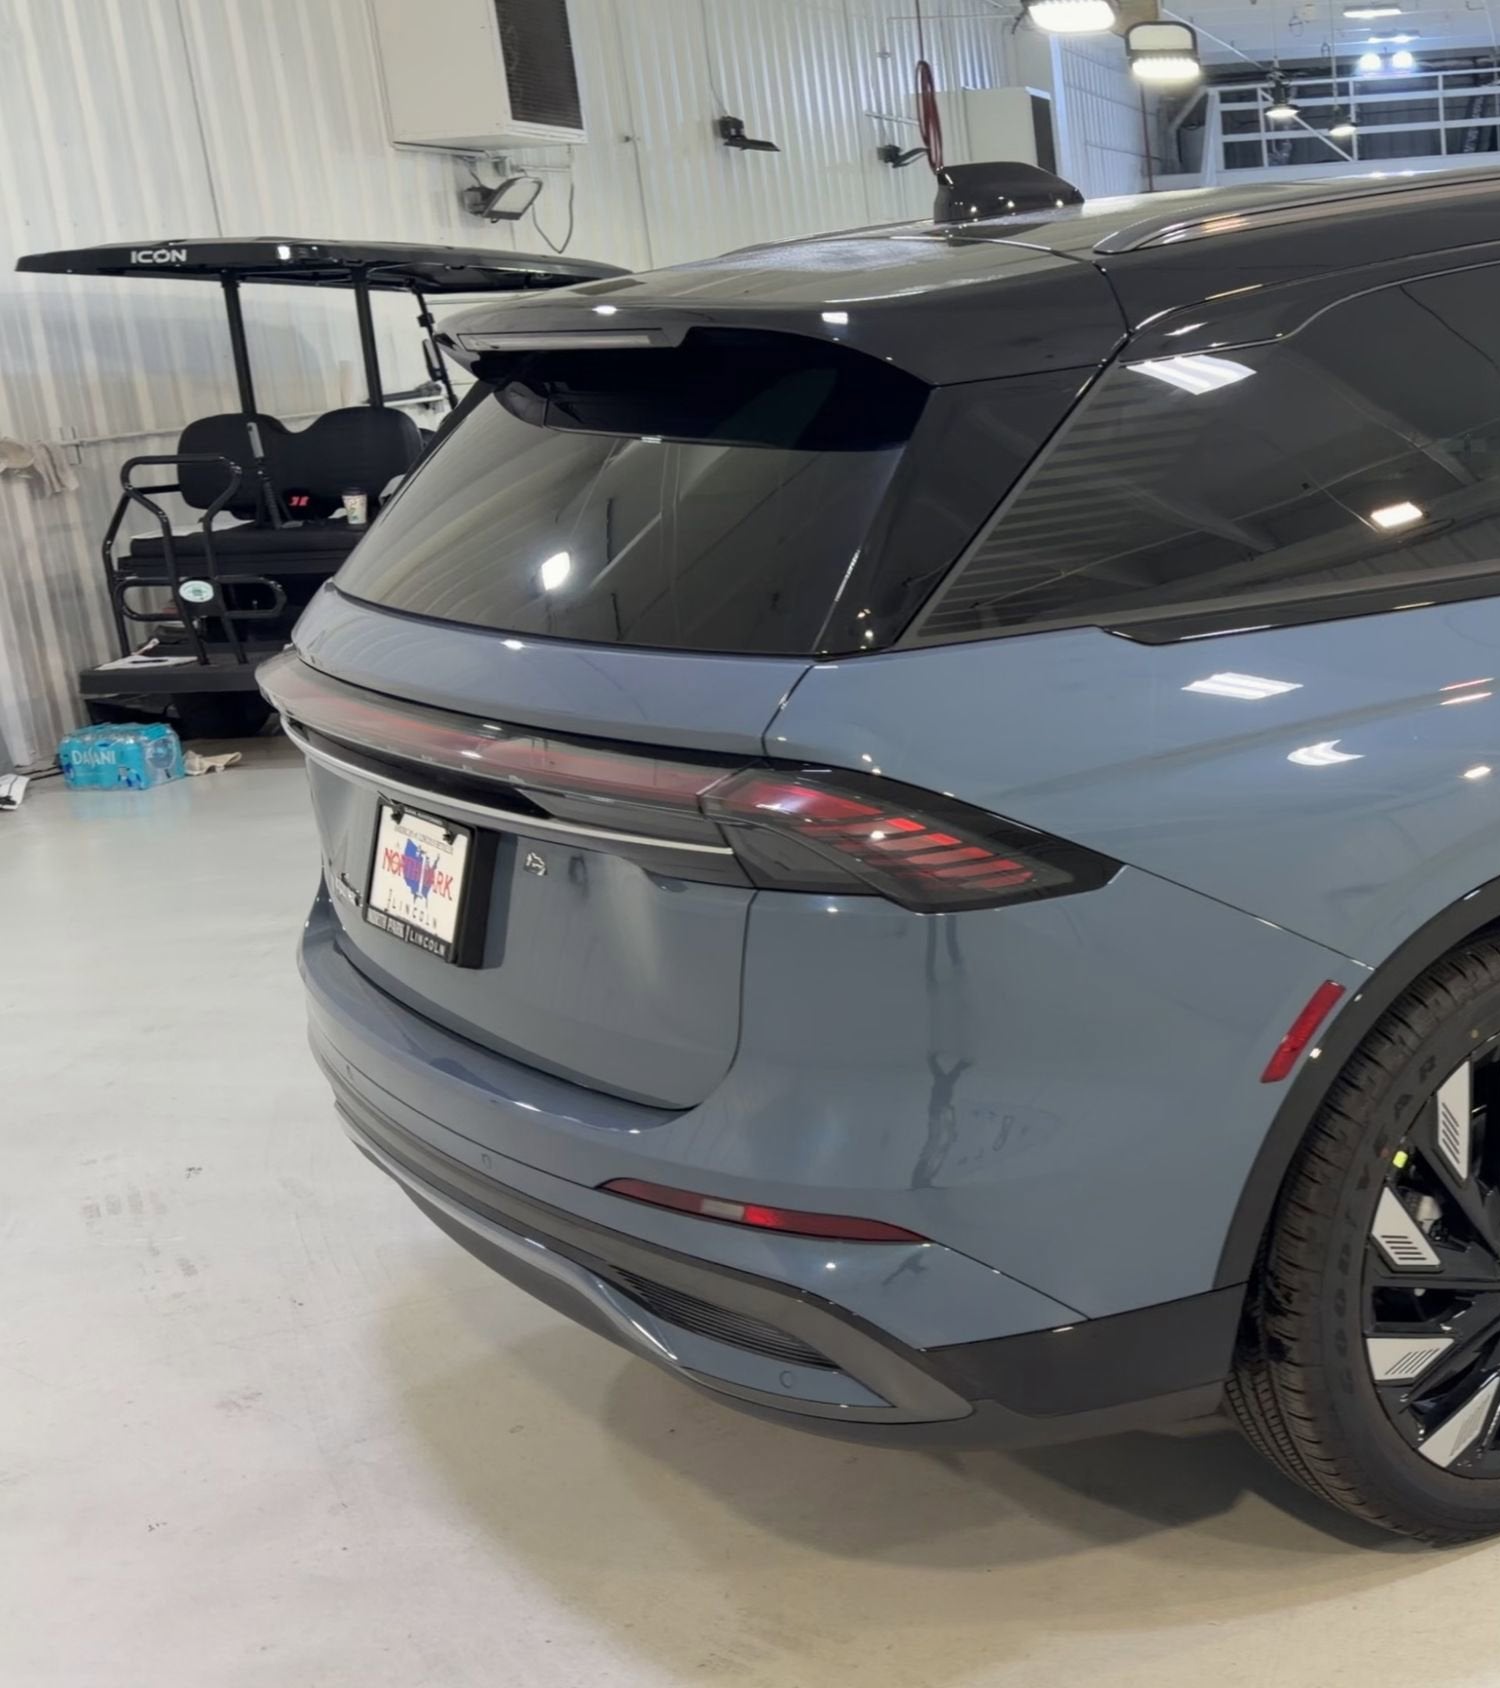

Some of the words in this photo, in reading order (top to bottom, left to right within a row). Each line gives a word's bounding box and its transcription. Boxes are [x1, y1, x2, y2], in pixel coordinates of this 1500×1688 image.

[131, 249, 187, 264] ICON
[71, 748, 117, 768] DASANI
[391, 897, 438, 929] LINCOLN
[410, 929, 446, 956] LINCOLN
